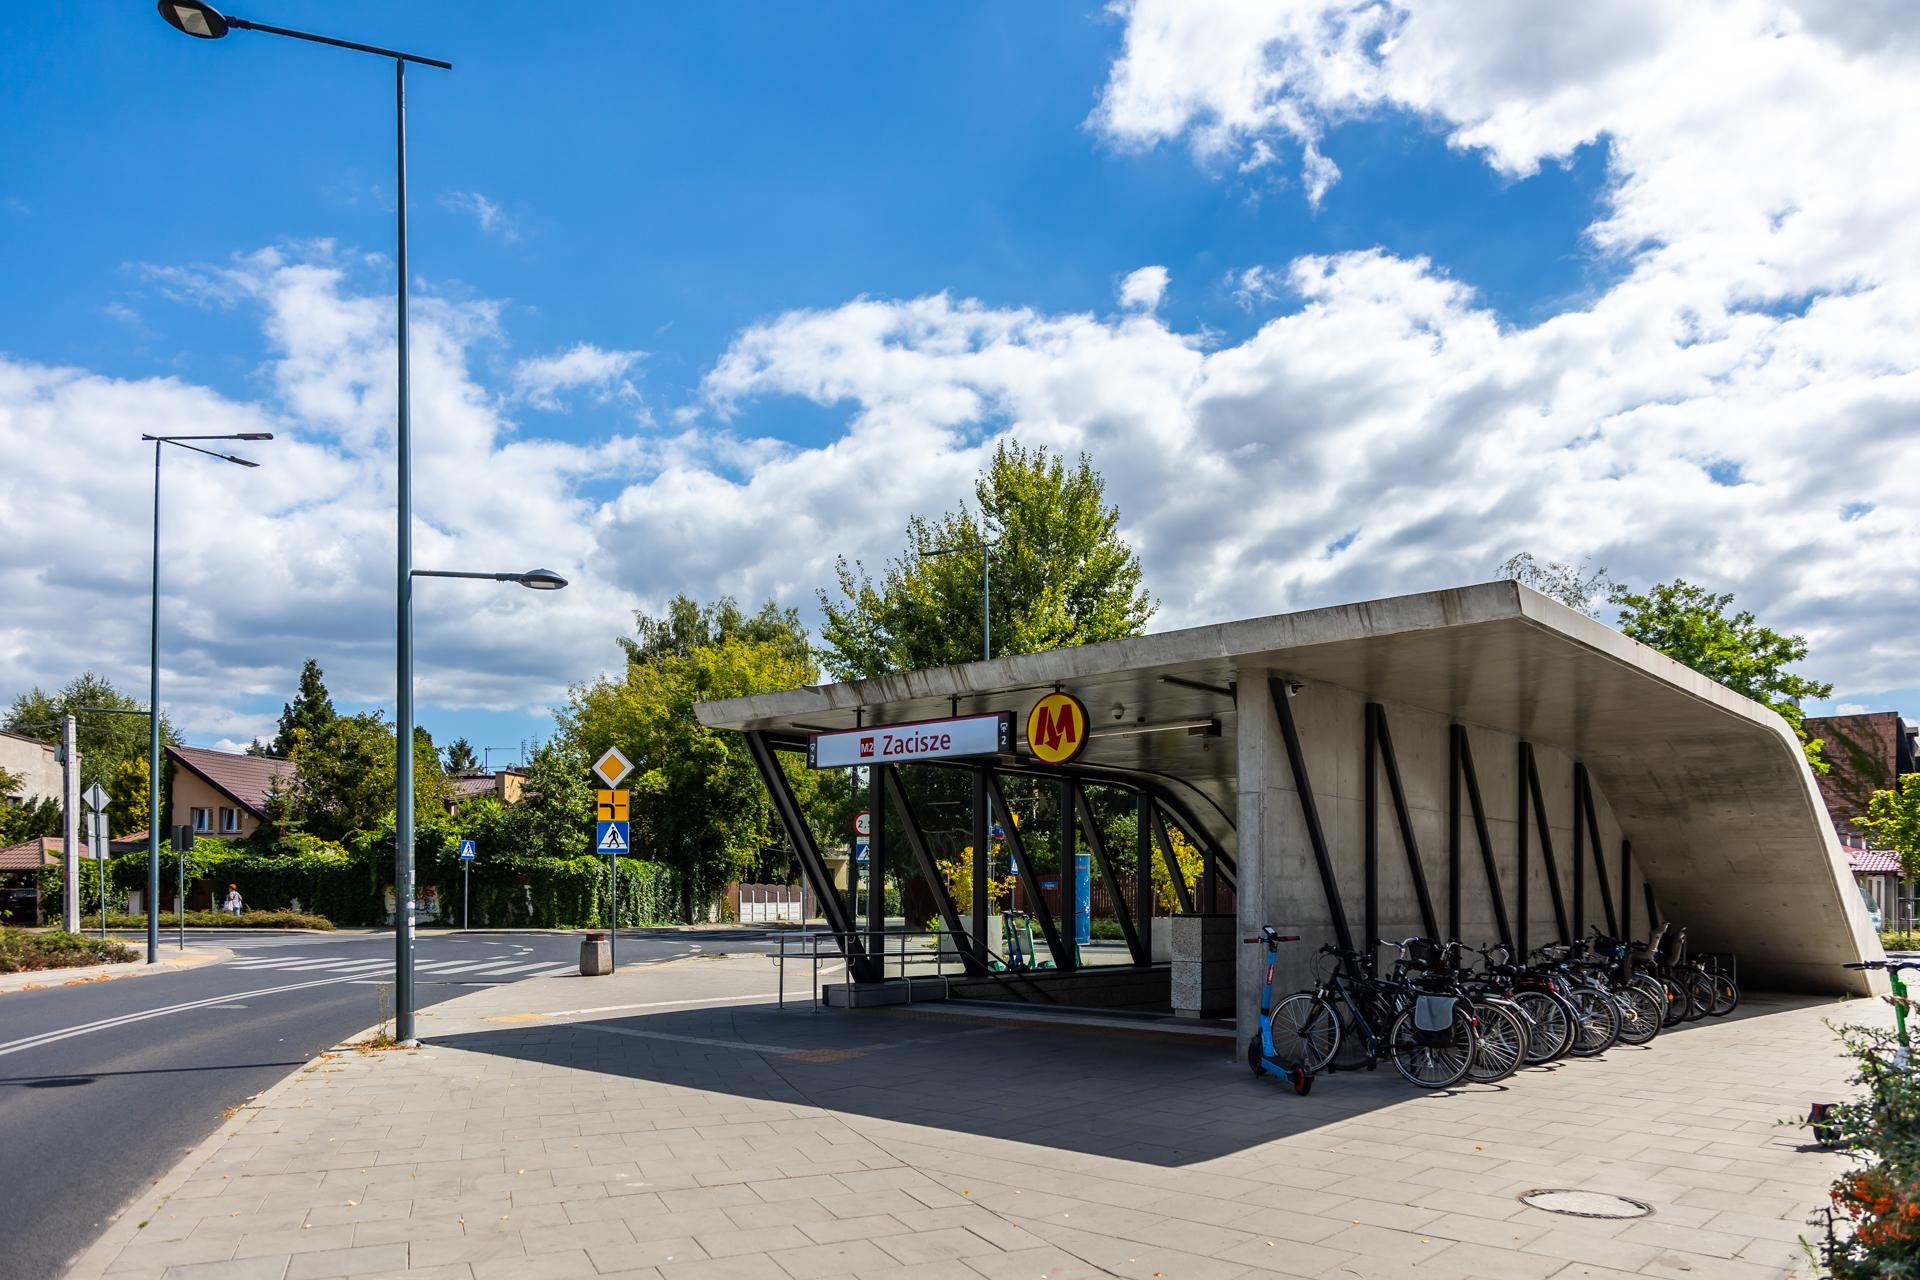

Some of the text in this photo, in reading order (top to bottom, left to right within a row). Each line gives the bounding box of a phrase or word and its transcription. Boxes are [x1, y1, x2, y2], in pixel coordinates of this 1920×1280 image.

[1034, 703, 1076, 752] M
[861, 731, 951, 755] M2 Zacisze
[1001, 735, 1007, 745] 2
[810, 754, 815, 763] 2
